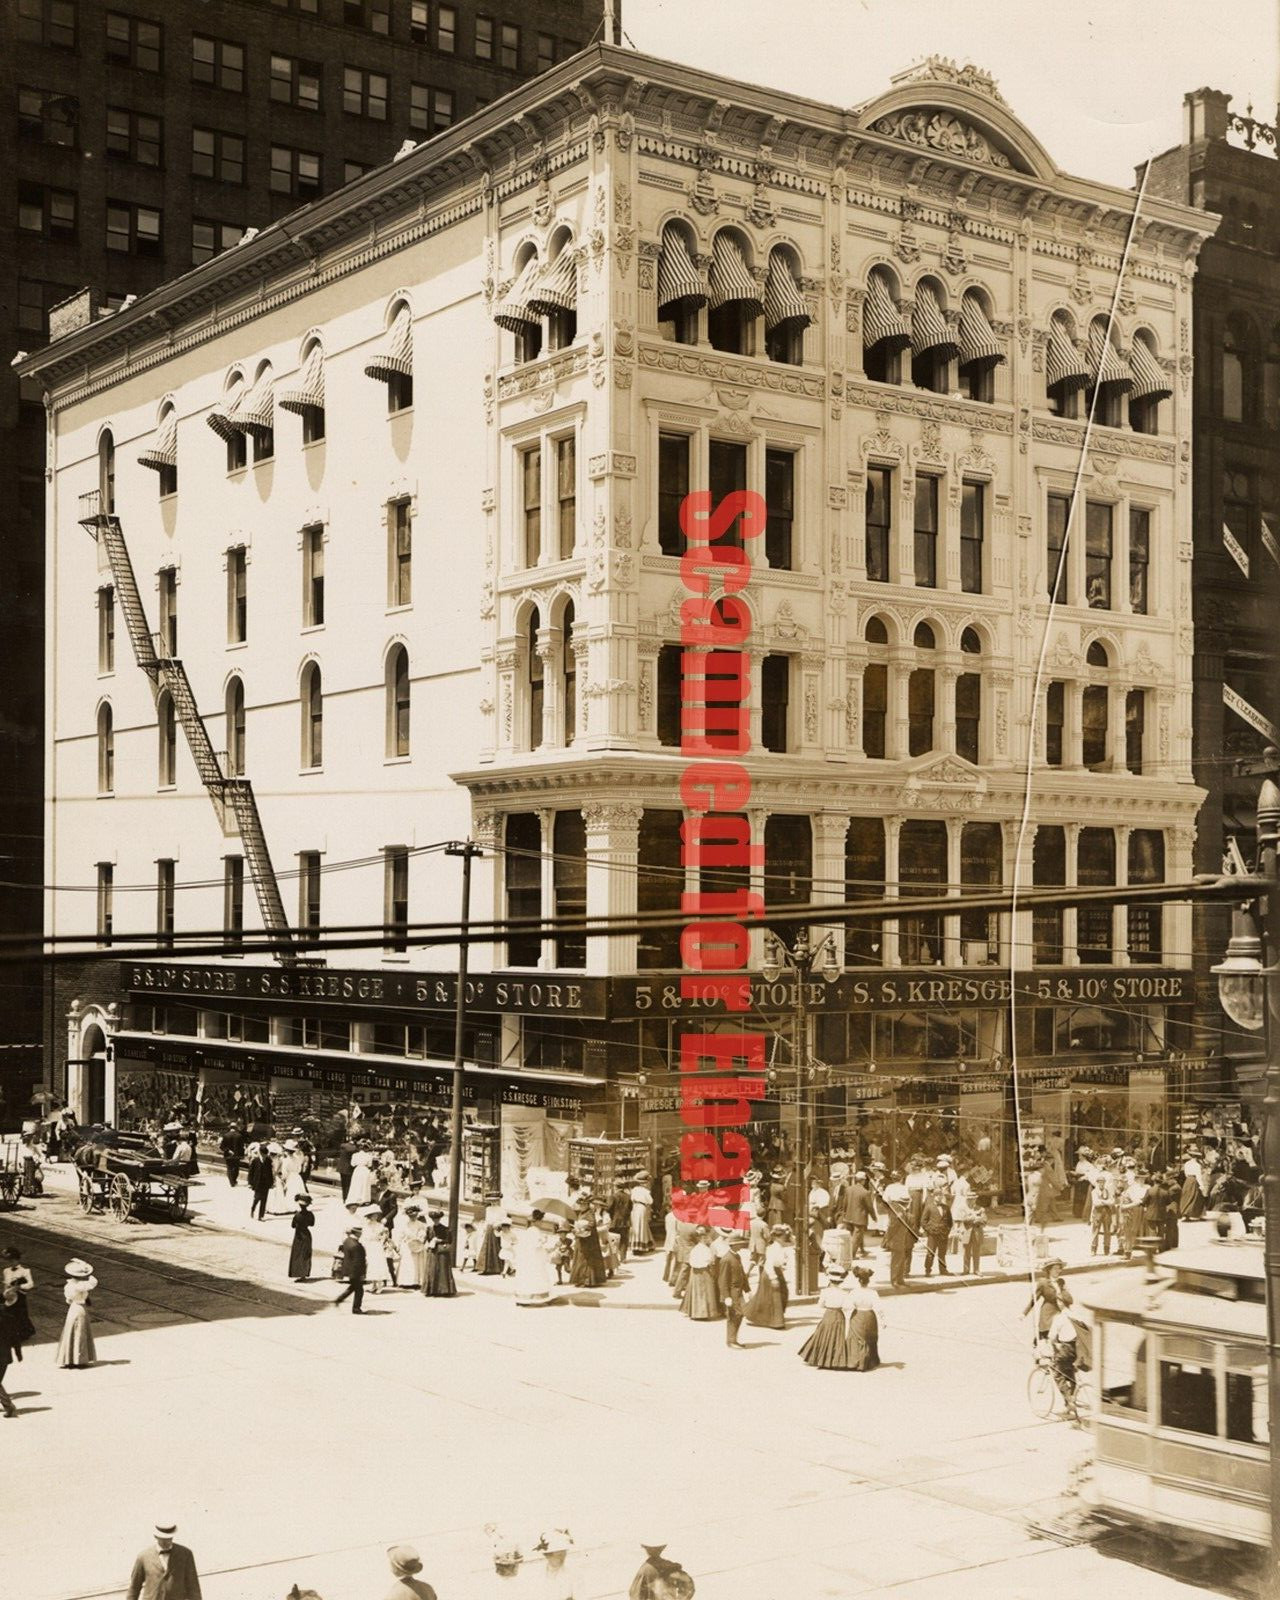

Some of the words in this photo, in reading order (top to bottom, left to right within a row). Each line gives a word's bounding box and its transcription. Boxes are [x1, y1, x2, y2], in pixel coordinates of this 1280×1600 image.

[182, 969, 237, 991] STORE
[299, 975, 384, 1000] KRESGE
[495, 982, 583, 1009] STORE
[908, 979, 1013, 1003] KRESGE
[1113, 977, 1183, 998] STORE
[855, 1087, 884, 1099] STORE
